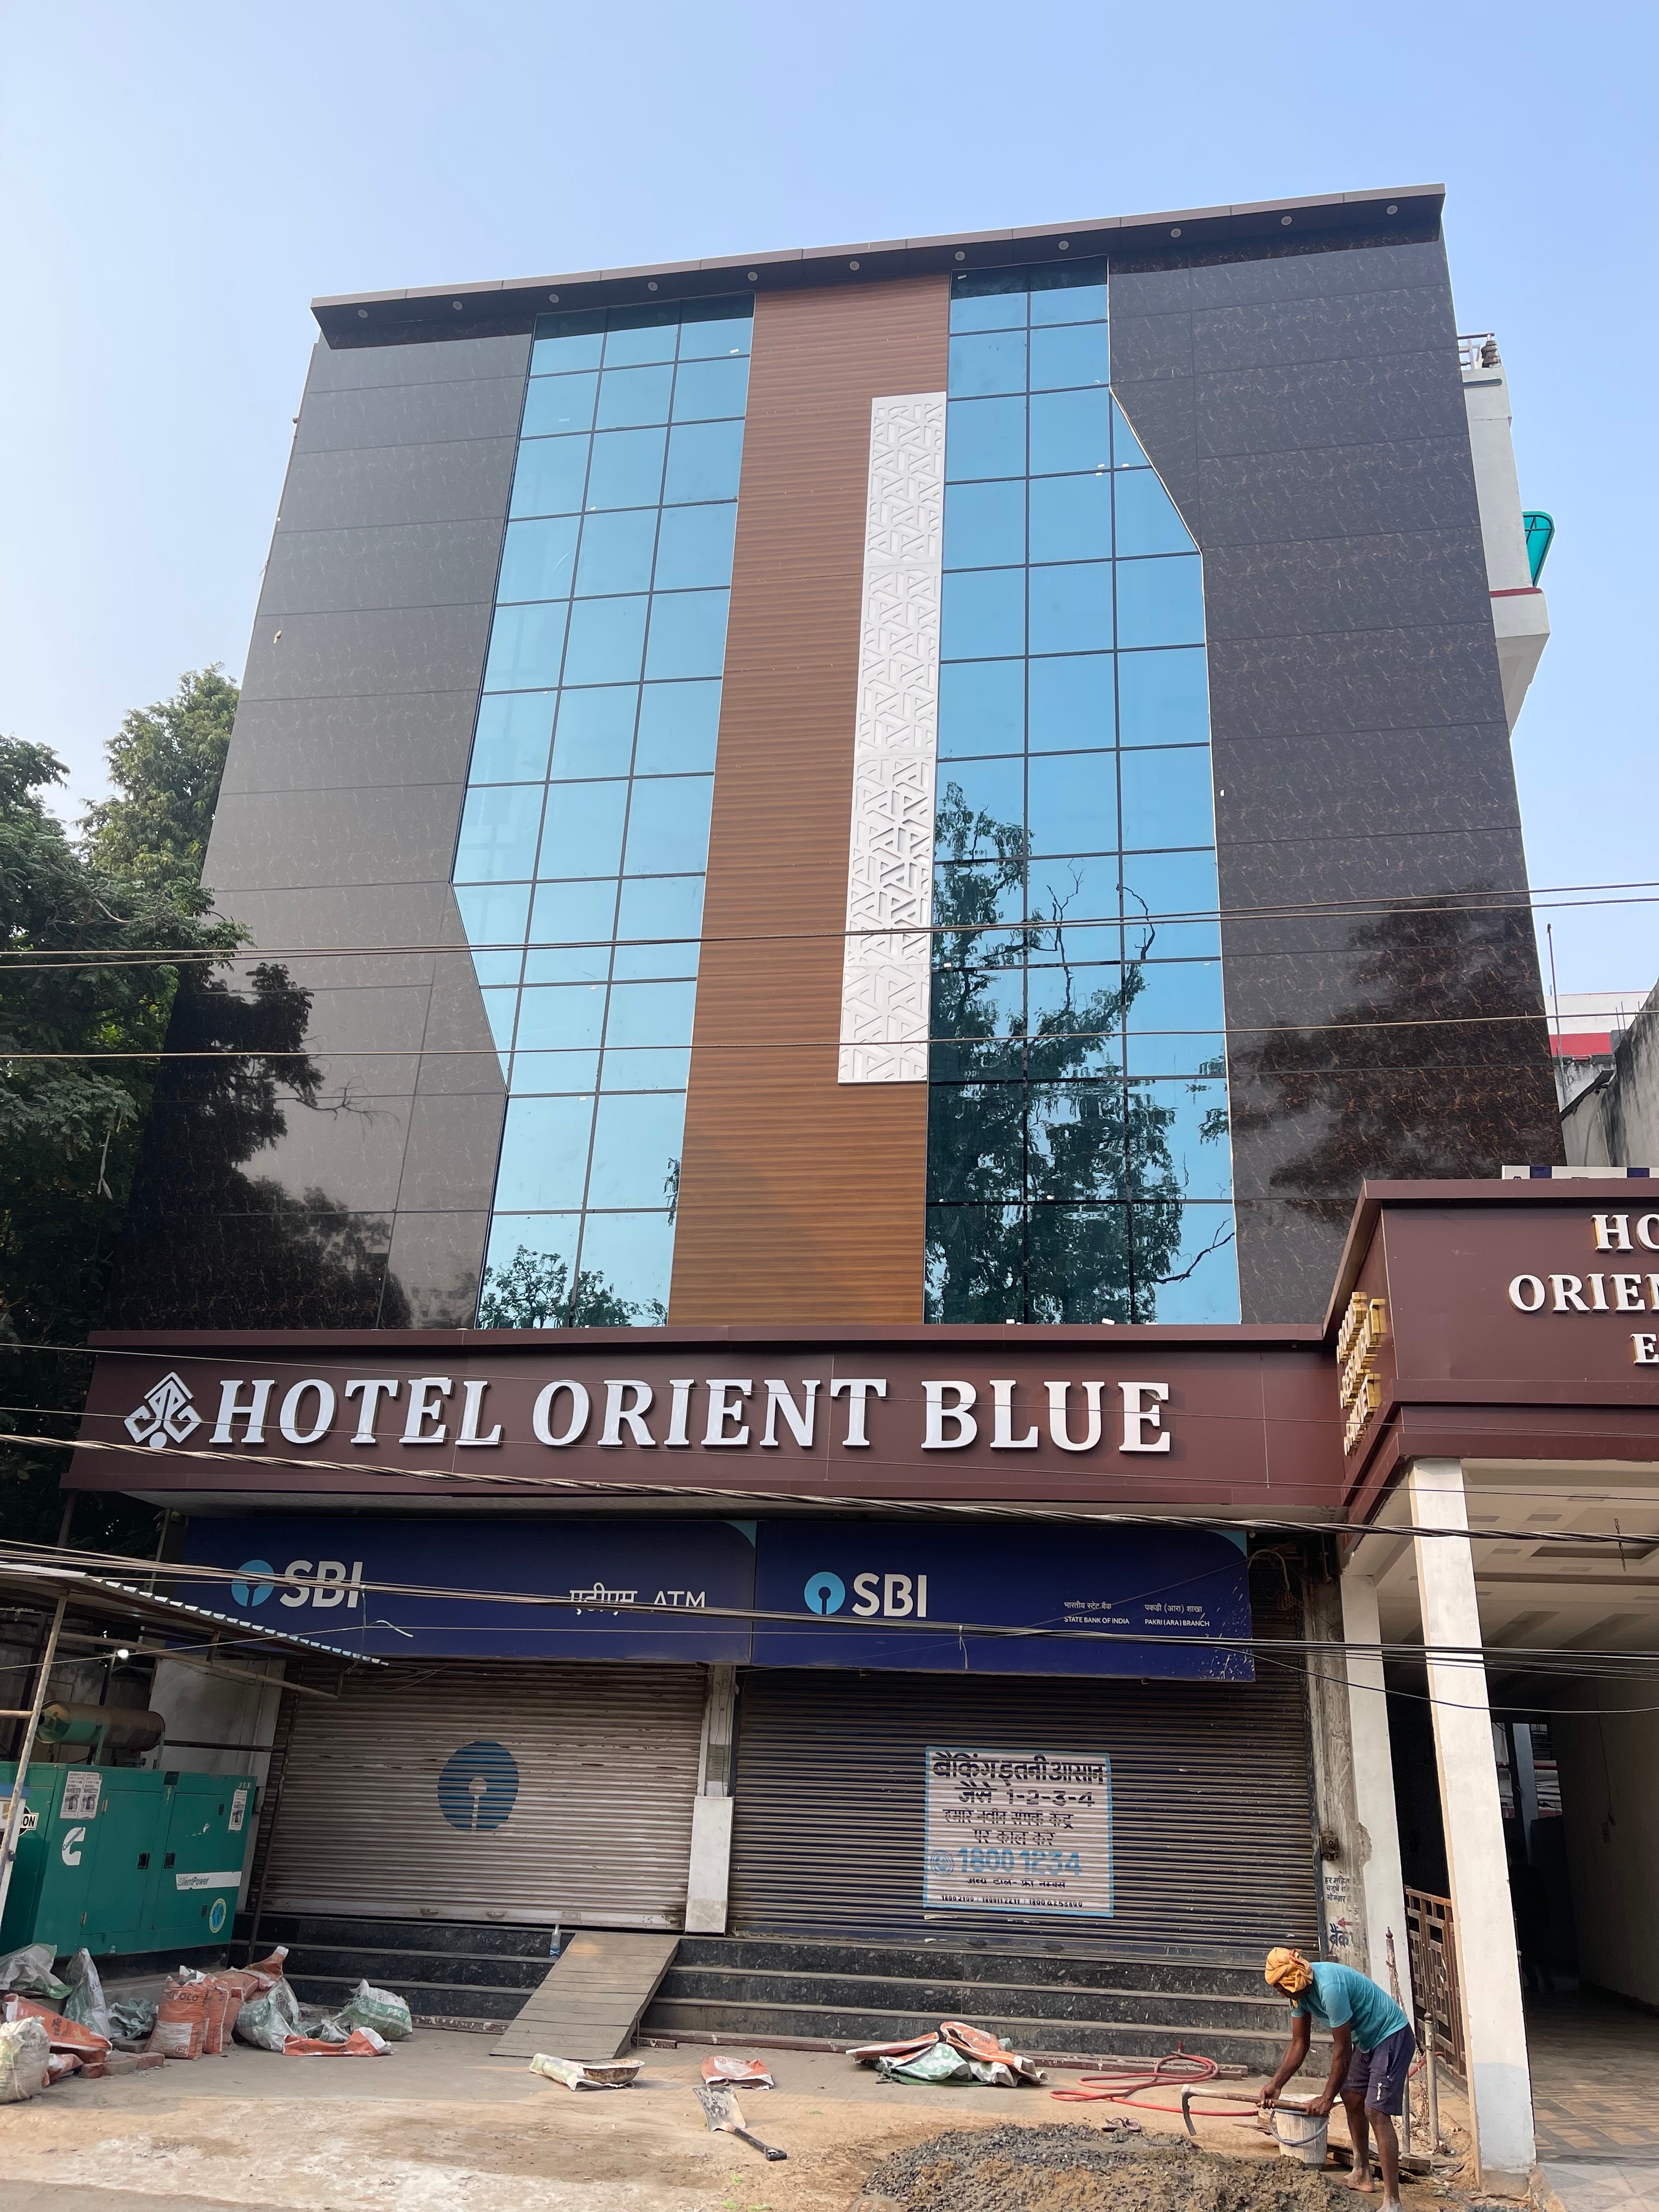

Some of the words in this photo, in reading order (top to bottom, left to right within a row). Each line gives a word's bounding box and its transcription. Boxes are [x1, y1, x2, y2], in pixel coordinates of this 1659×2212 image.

[208, 1377, 502, 1446] HOTEL
[532, 1378, 887, 1448] ORIENT
[920, 1379, 1171, 1452] BLUE
[279, 1560, 363, 1608] SBI
[852, 1572, 927, 1617] SBI
[653, 1590, 706, 1610] ATM
[1064, 1600, 1085, 1609] भारतीय
[1087, 1601, 1100, 1610] स्टेट
[1164, 1603, 1184, 1613] (आरा)
[1049, 1762, 1105, 1784] आसान
[1006, 1789, 1095, 1807] 1-2-3-4
[957, 1847, 1015, 1873] 1800
[1019, 1849, 1083, 1876] 1234
